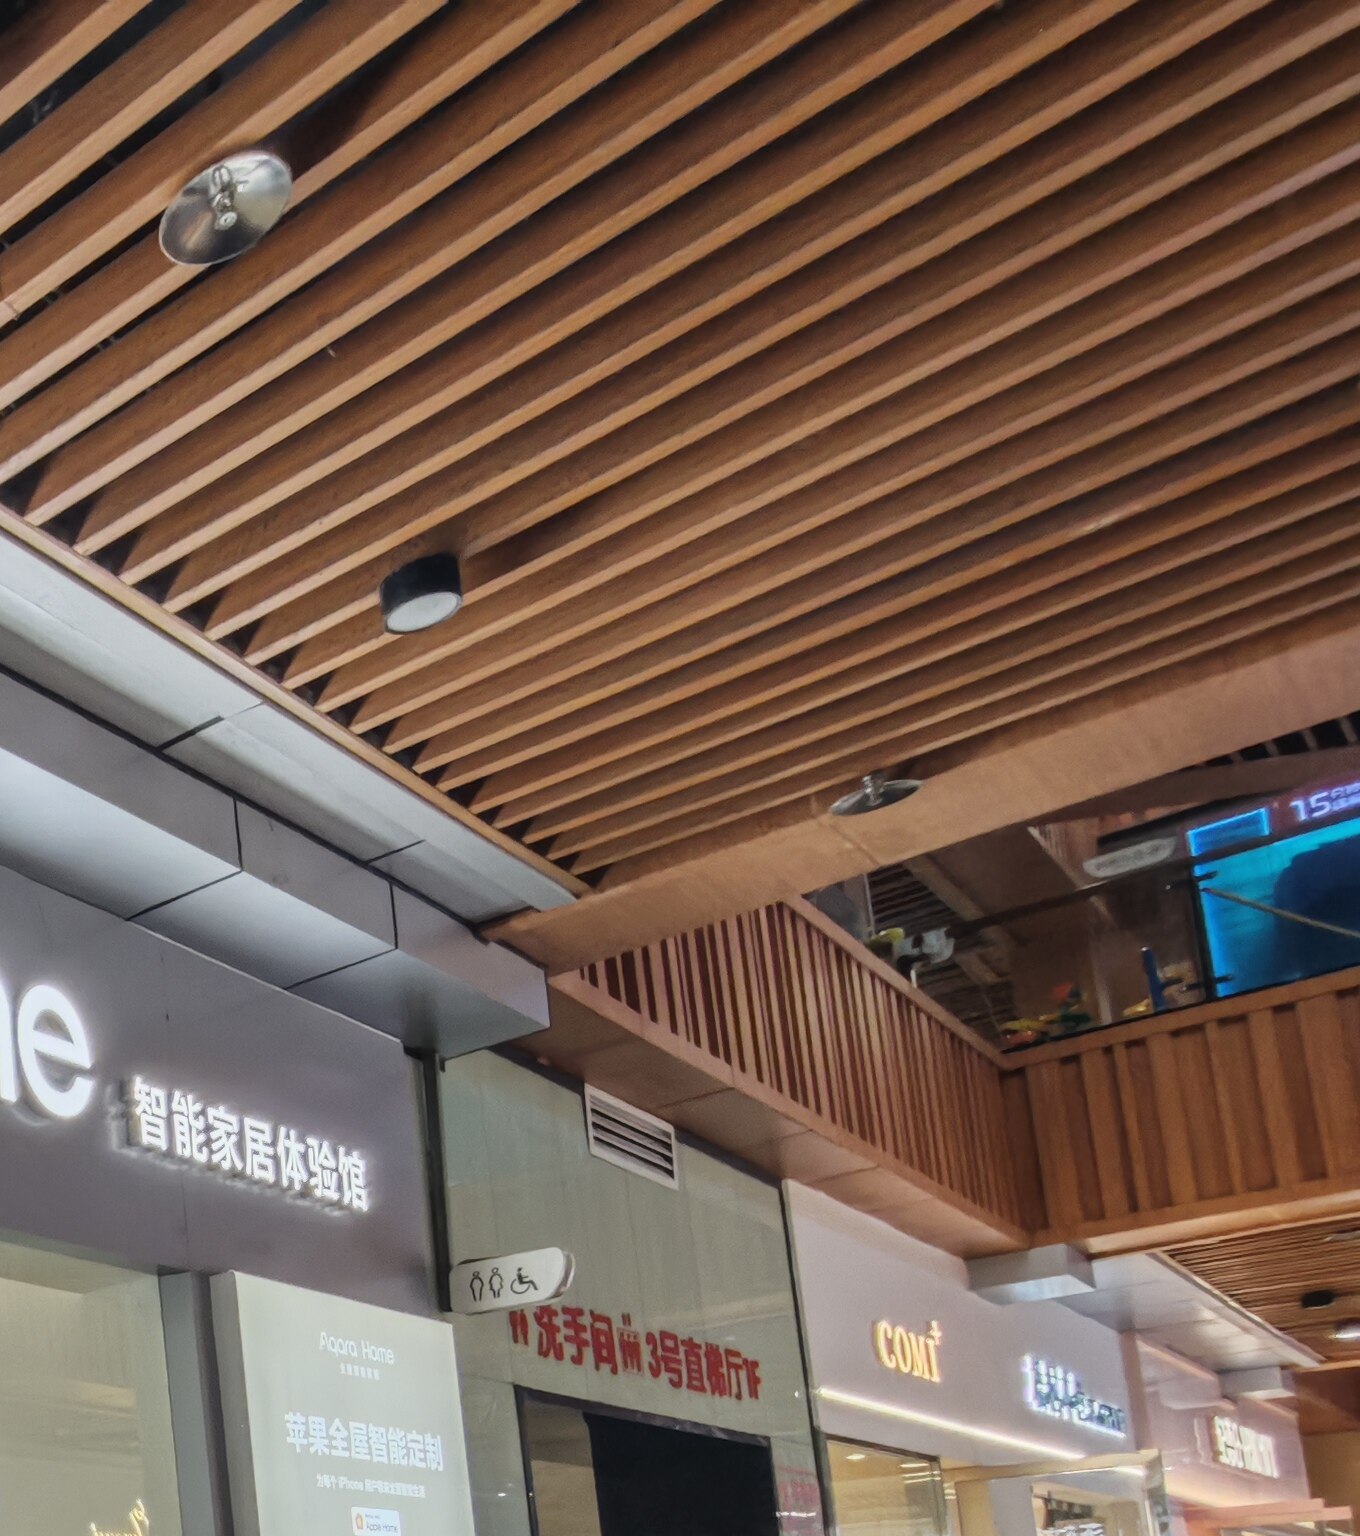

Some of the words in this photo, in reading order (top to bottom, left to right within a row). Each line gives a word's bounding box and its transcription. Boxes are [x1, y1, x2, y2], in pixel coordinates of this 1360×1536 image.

[131, 1075, 370, 1213] 智能家居体验馆
[319, 1331, 358, 1357] Aqara
[361, 1339, 395, 1365] Home
[533, 1304, 619, 1376] 洗手间
[284, 1411, 444, 1472] 苹果全屋智能定制
